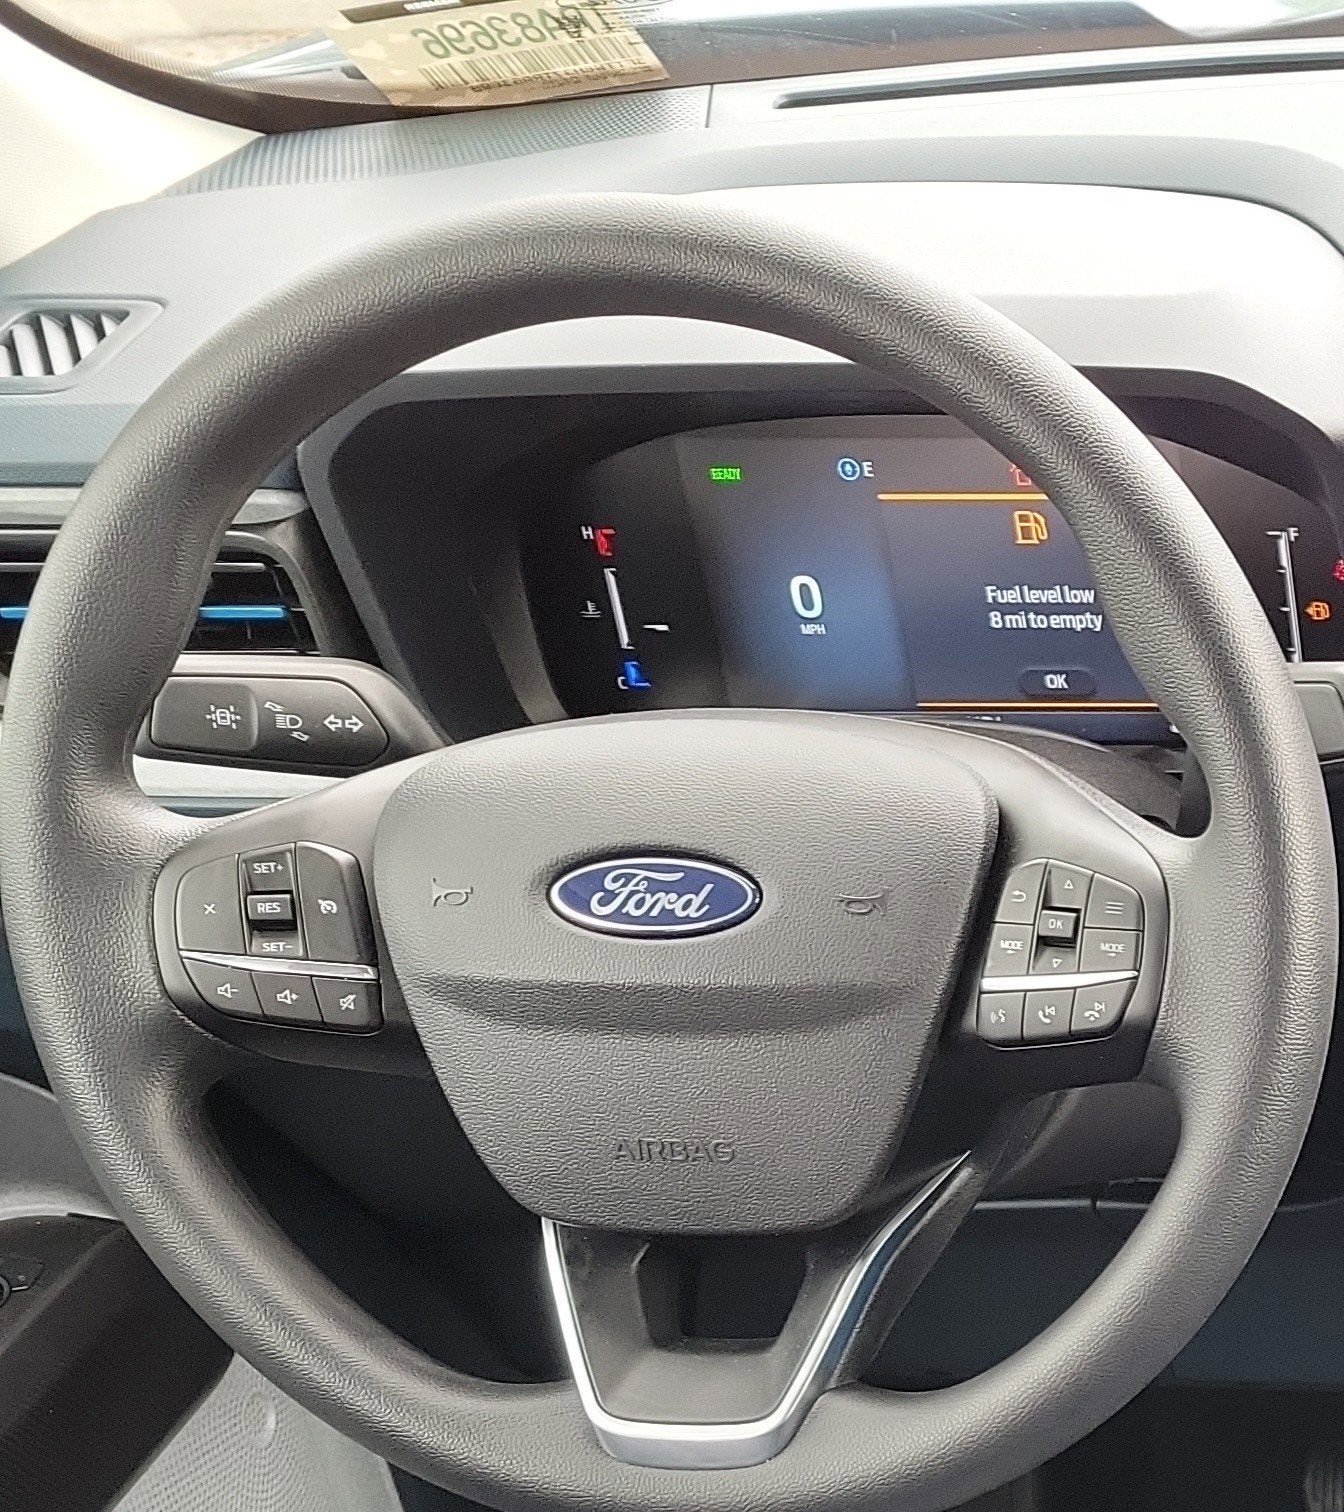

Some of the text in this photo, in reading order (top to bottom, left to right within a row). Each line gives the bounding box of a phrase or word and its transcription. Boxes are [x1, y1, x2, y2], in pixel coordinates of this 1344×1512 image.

[862, 461, 875, 477] E
[580, 526, 594, 540] H
[1288, 527, 1300, 541] F
[789, 574, 823, 619] 0
[986, 585, 1095, 604] Fuel level low
[989, 611, 1103, 632] 8 mi to empty
[800, 623, 827, 635] MPH
[617, 676, 628, 690] C
[1044, 674, 1069, 690] OK
[253, 861, 284, 874] SET+
[589, 867, 713, 920] Ford
[257, 902, 281, 915] RES
[1048, 919, 1064, 930] OK
[1000, 940, 1024, 952] MODE
[1100, 942, 1125, 955] MODE
[613, 1137, 736, 1166] AIRBAG
